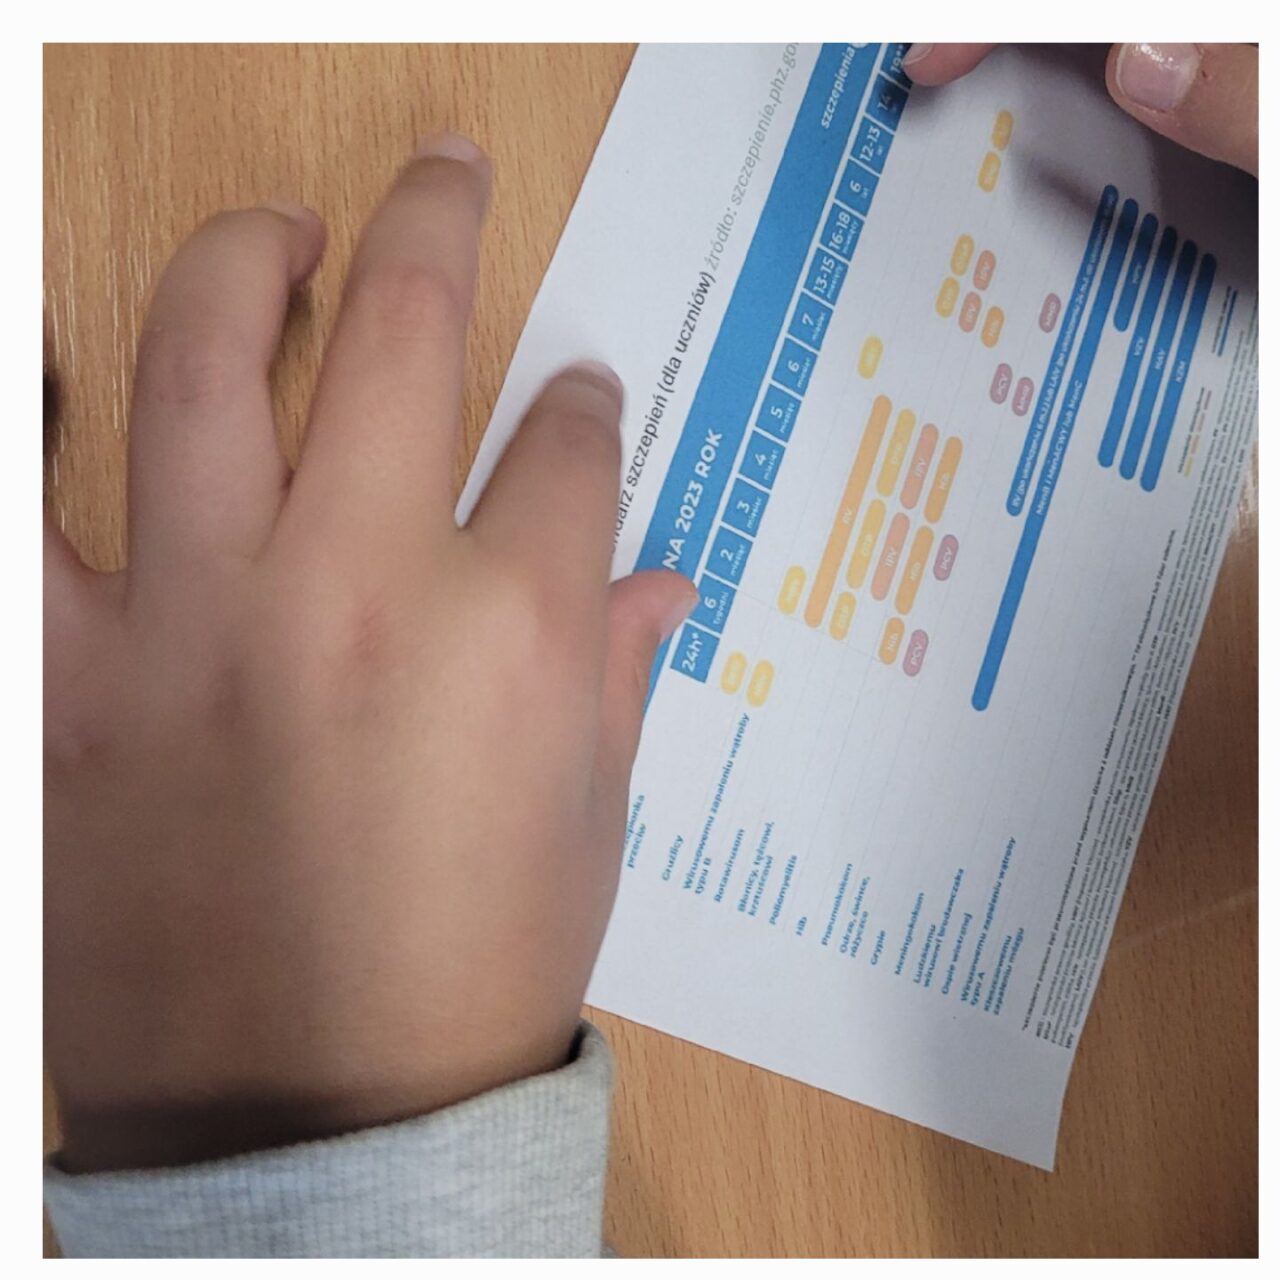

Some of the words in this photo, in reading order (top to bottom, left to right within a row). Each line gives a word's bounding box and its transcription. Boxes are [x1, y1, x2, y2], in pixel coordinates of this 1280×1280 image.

[819, 45, 857, 129] szczepienia
[624, 393, 669, 488] szczepień
[658, 356, 682, 393] (dla
[674, 270, 715, 354] uczniów)
[703, 205, 737, 270] źródło:
[728, 43, 801, 207] szczepienie.phz.go
[704, 596, 716, 609] 6
[721, 548, 733, 560] 2
[737, 499, 750, 512] 3
[754, 452, 766, 465] 4
[771, 405, 783, 417] 5
[787, 360, 800, 372] 6
[803, 313, 815, 326] 7
[814, 256, 835, 293] 13-15
[829, 211, 851, 249] 16-18
[849, 180, 861, 192] 6
[861, 125, 881, 161] 12-13
[663, 535, 684, 569] NA
[675, 480, 703, 533] 2023
[694, 429, 721, 477] ROK
[682, 814, 714, 890] Wirusowemu
[728, 712, 750, 758] wątroby
[626, 822, 647, 868] przeciw
[694, 868, 709, 894] typu
[714, 827, 744, 902] Rotawirusom
[768, 854, 798, 924] Poliomyelitis
